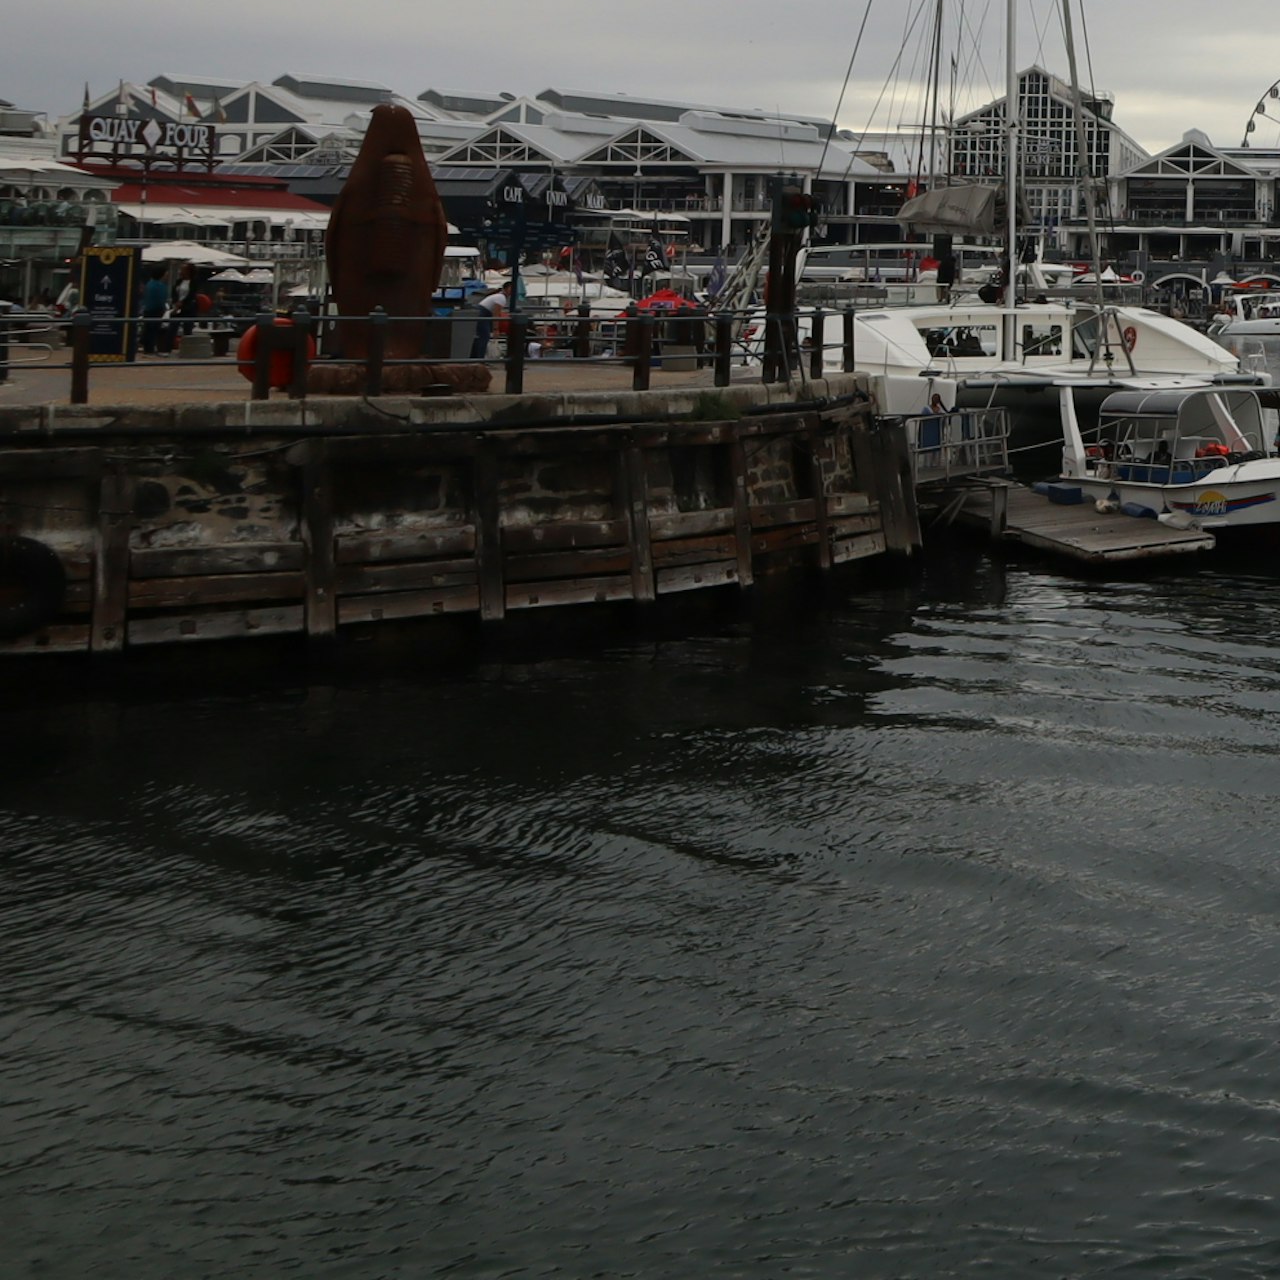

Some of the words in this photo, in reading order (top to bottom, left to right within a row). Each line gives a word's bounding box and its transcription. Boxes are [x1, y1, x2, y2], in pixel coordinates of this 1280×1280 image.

[90, 117, 141, 142] QUAY
[165, 123, 209, 147] FOUR
[503, 186, 523, 203] CAPE
[546, 190, 568, 206] UNION
[586, 193, 605, 209] MART
